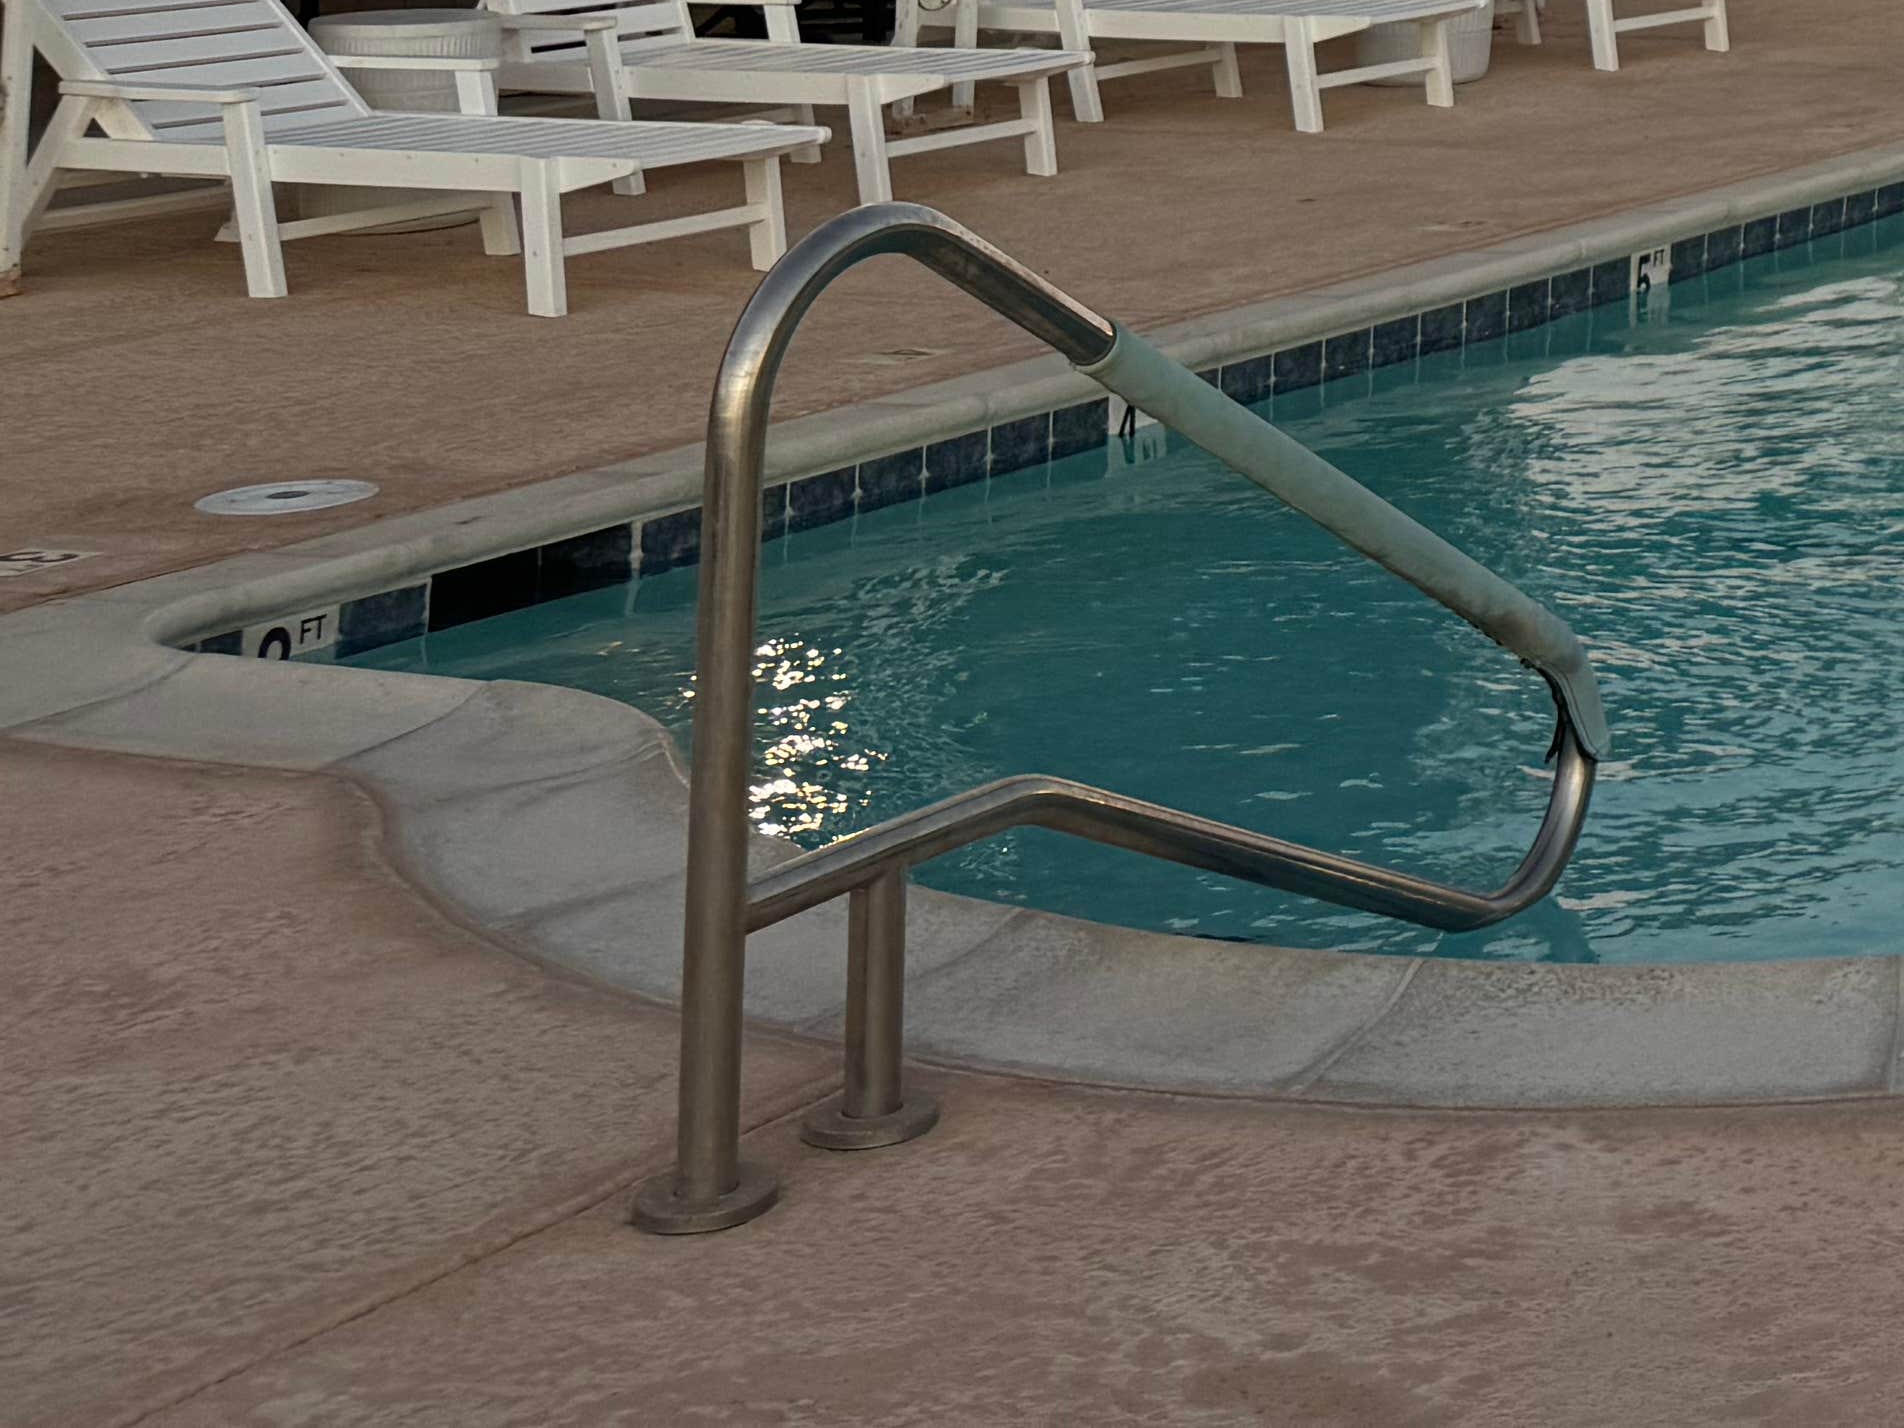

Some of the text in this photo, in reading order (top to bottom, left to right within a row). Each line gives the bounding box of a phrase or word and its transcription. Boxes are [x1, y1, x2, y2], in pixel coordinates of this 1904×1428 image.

[1637, 248, 1665, 293] 5 FT
[300, 613, 328, 644] FT
